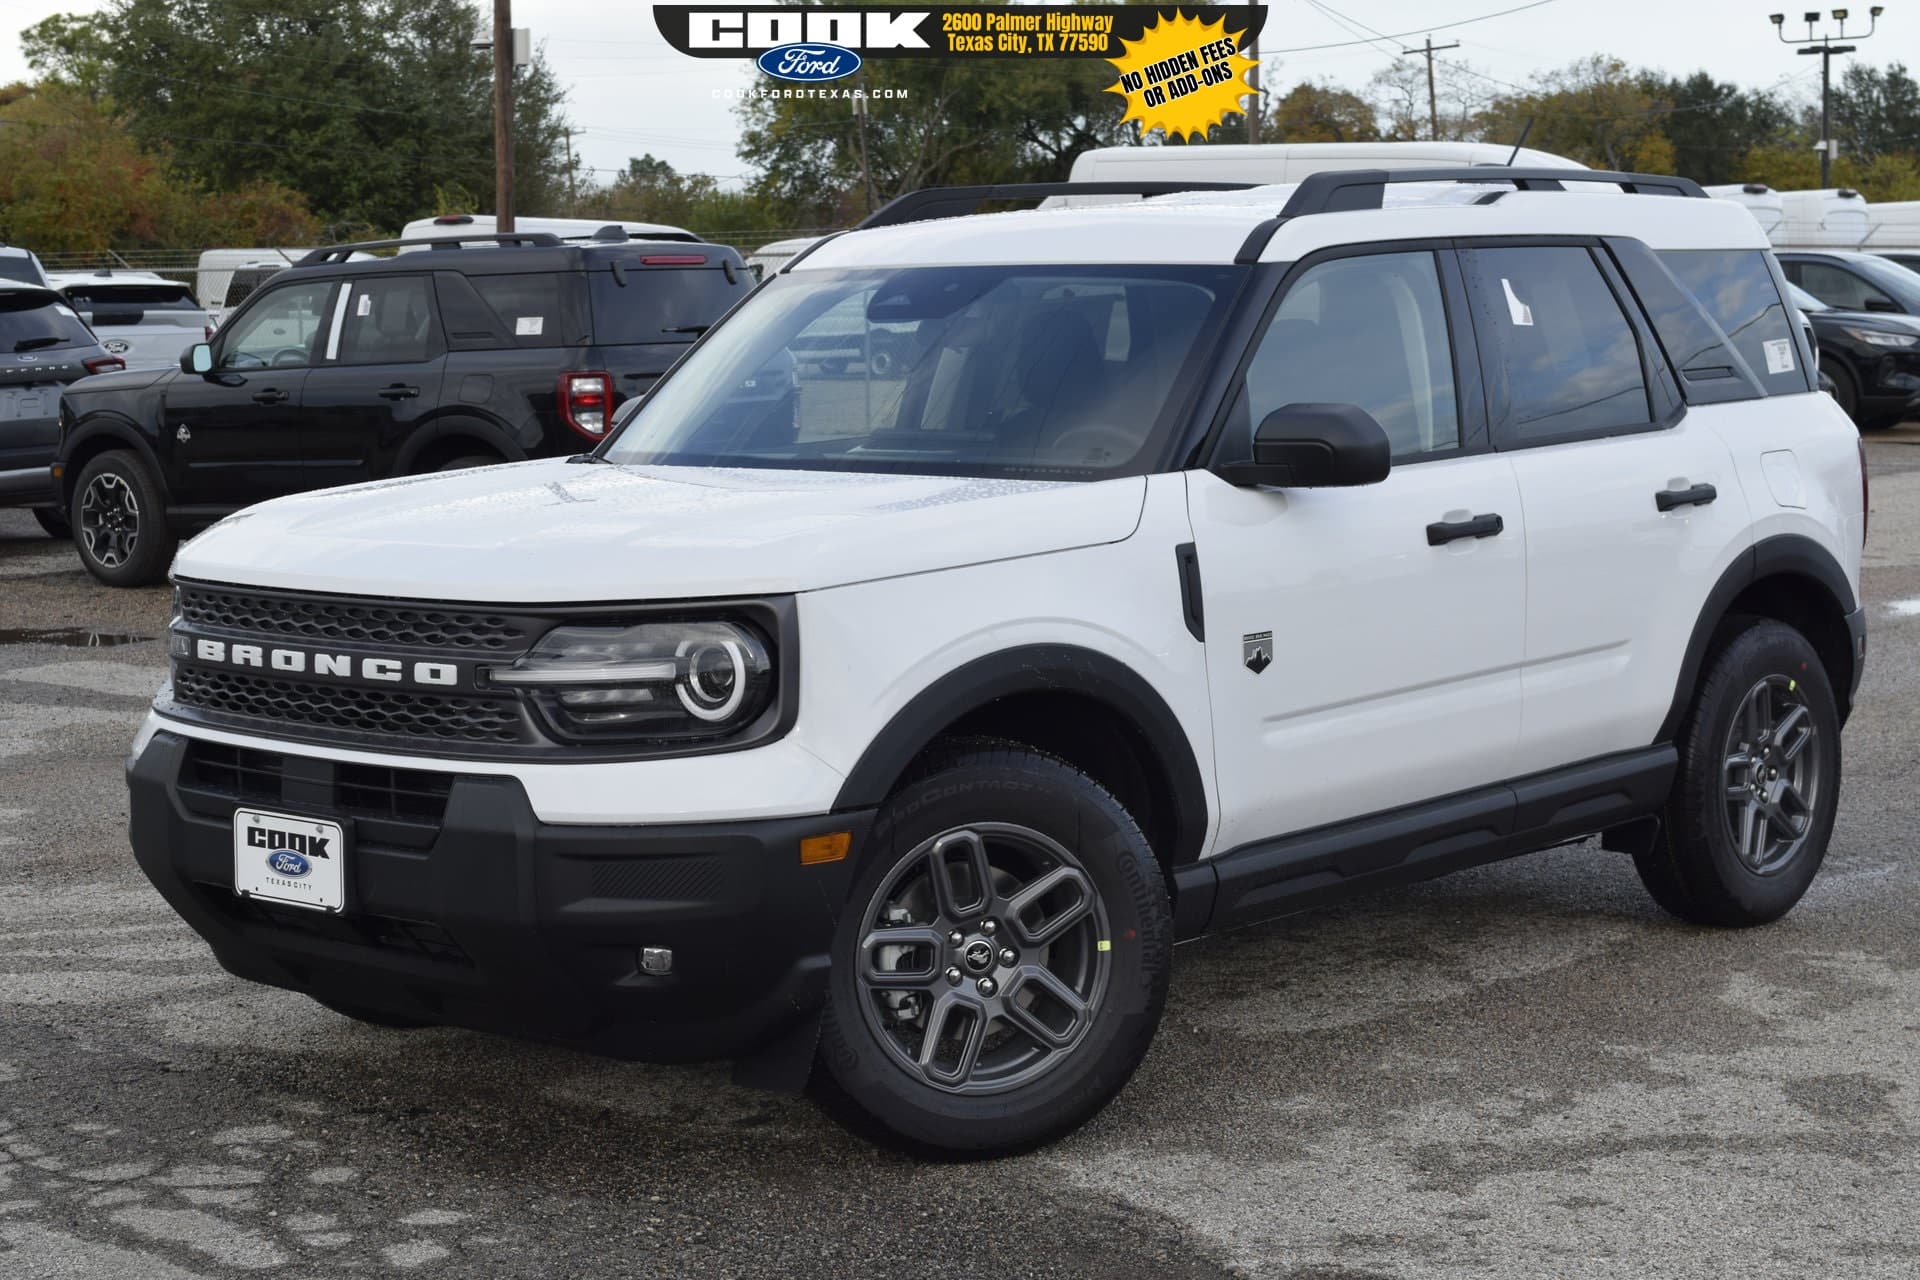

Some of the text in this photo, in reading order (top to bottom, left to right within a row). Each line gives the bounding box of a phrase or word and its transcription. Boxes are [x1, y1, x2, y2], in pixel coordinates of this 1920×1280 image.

[197, 639, 457, 686] BRONCO
[247, 825, 330, 860] COOK
[275, 853, 302, 874] Ford
